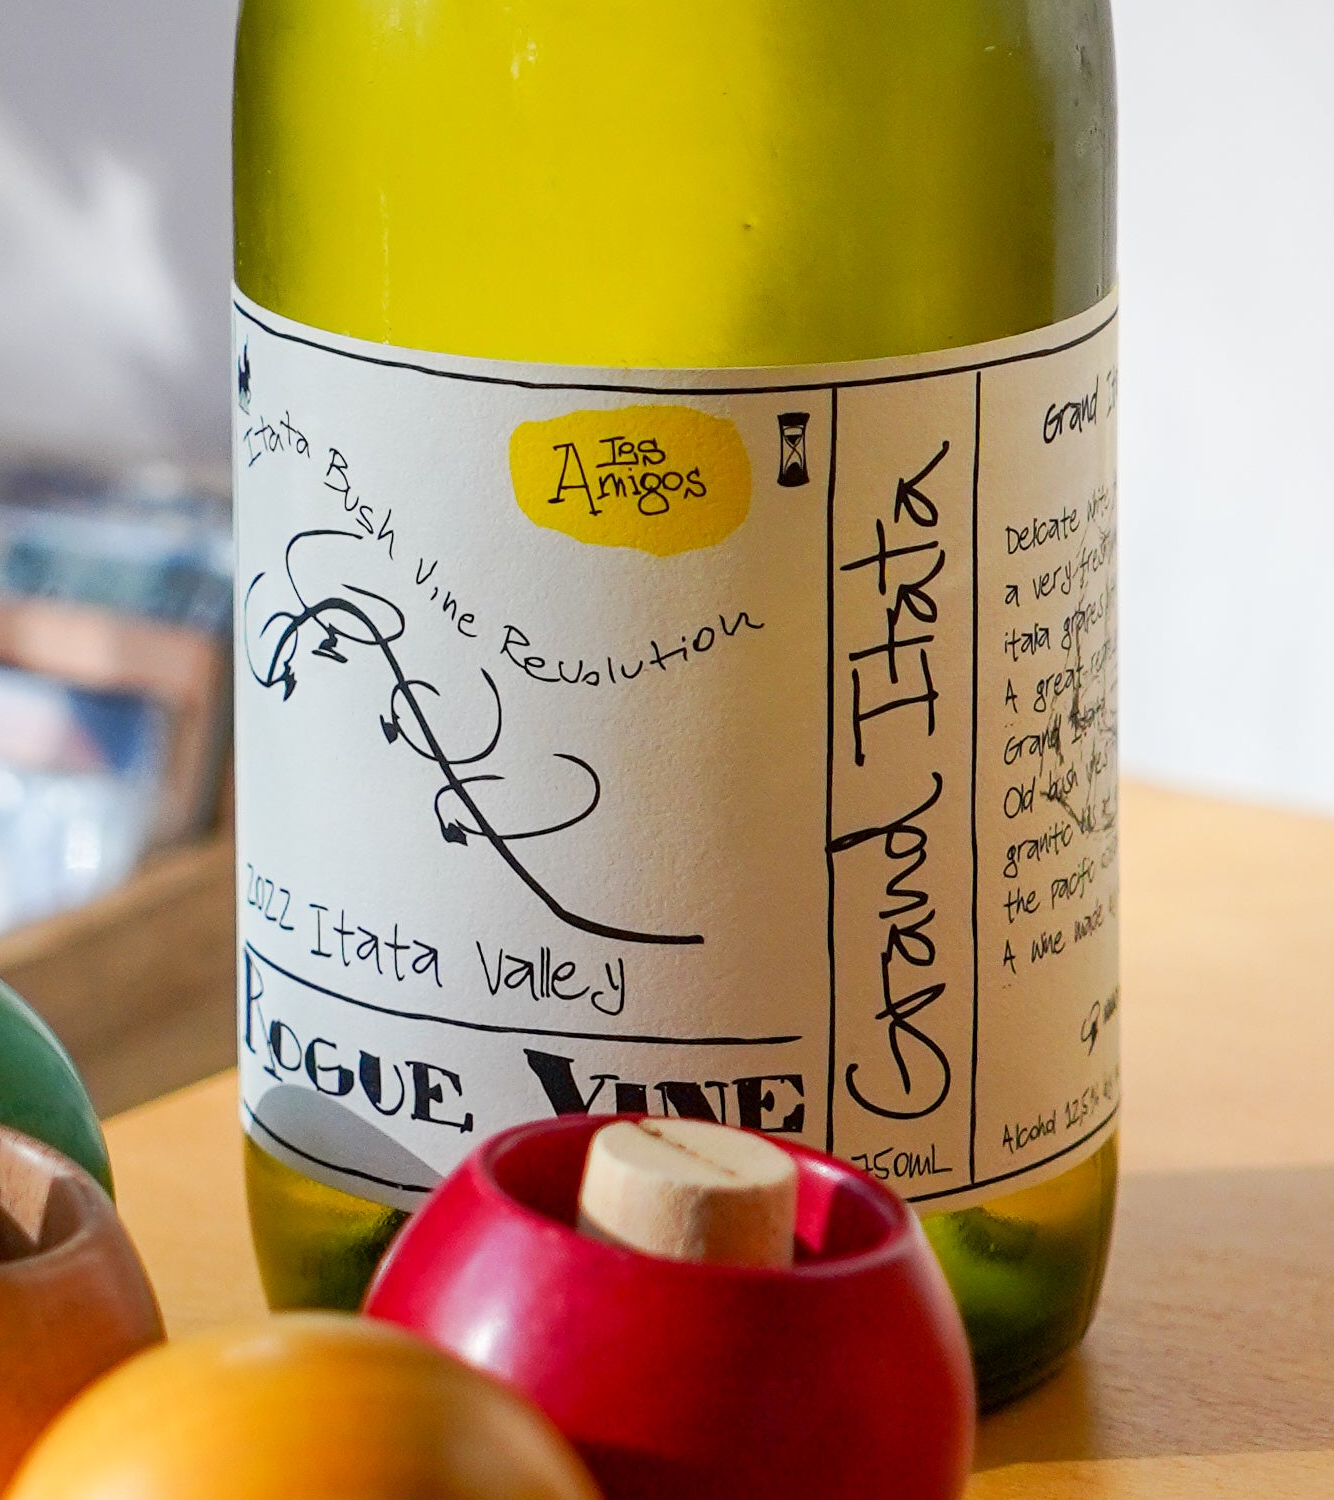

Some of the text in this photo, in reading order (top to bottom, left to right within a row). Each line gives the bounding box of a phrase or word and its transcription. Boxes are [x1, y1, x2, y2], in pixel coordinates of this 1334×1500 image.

[1042, 374, 1099, 445] Grand
[547, 441, 708, 517] Amigos
[242, 409, 310, 468] Itata
[323, 447, 395, 560] Bush
[500, 610, 765, 687] Revolution
[1004, 584, 1020, 607] a
[1032, 560, 1072, 600] very
[1033, 664, 1084, 713] great
[1003, 713, 1063, 766] Grand
[825, 440, 953, 1121] Grand Itata
[1003, 776, 1037, 819] Old
[1003, 887, 1041, 924] the
[245, 863, 627, 1017] 2022 Itata Valley
